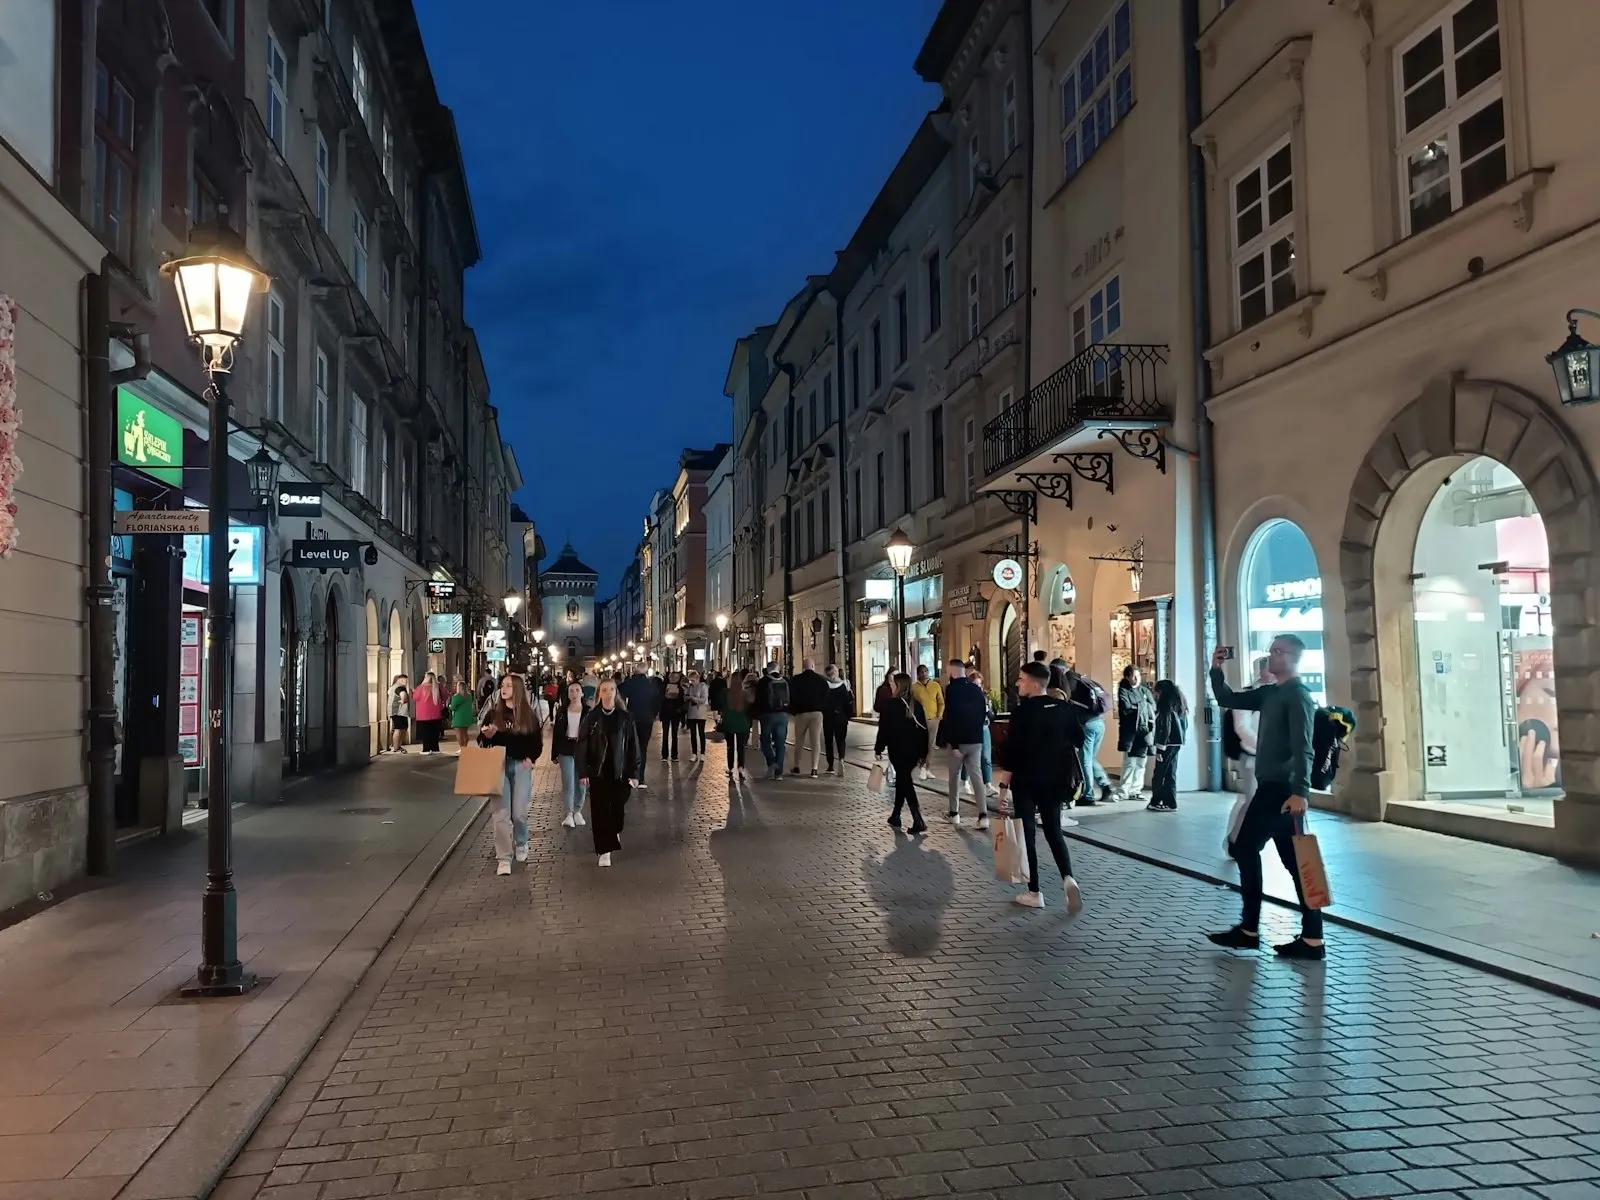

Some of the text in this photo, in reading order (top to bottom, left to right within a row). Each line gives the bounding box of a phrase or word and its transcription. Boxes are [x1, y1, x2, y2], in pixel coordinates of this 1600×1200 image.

[127, 511, 199, 522] Apartamenty
[126, 523, 200, 532] FLORIAŃSKA 16
[300, 549, 350, 561] Level Up
